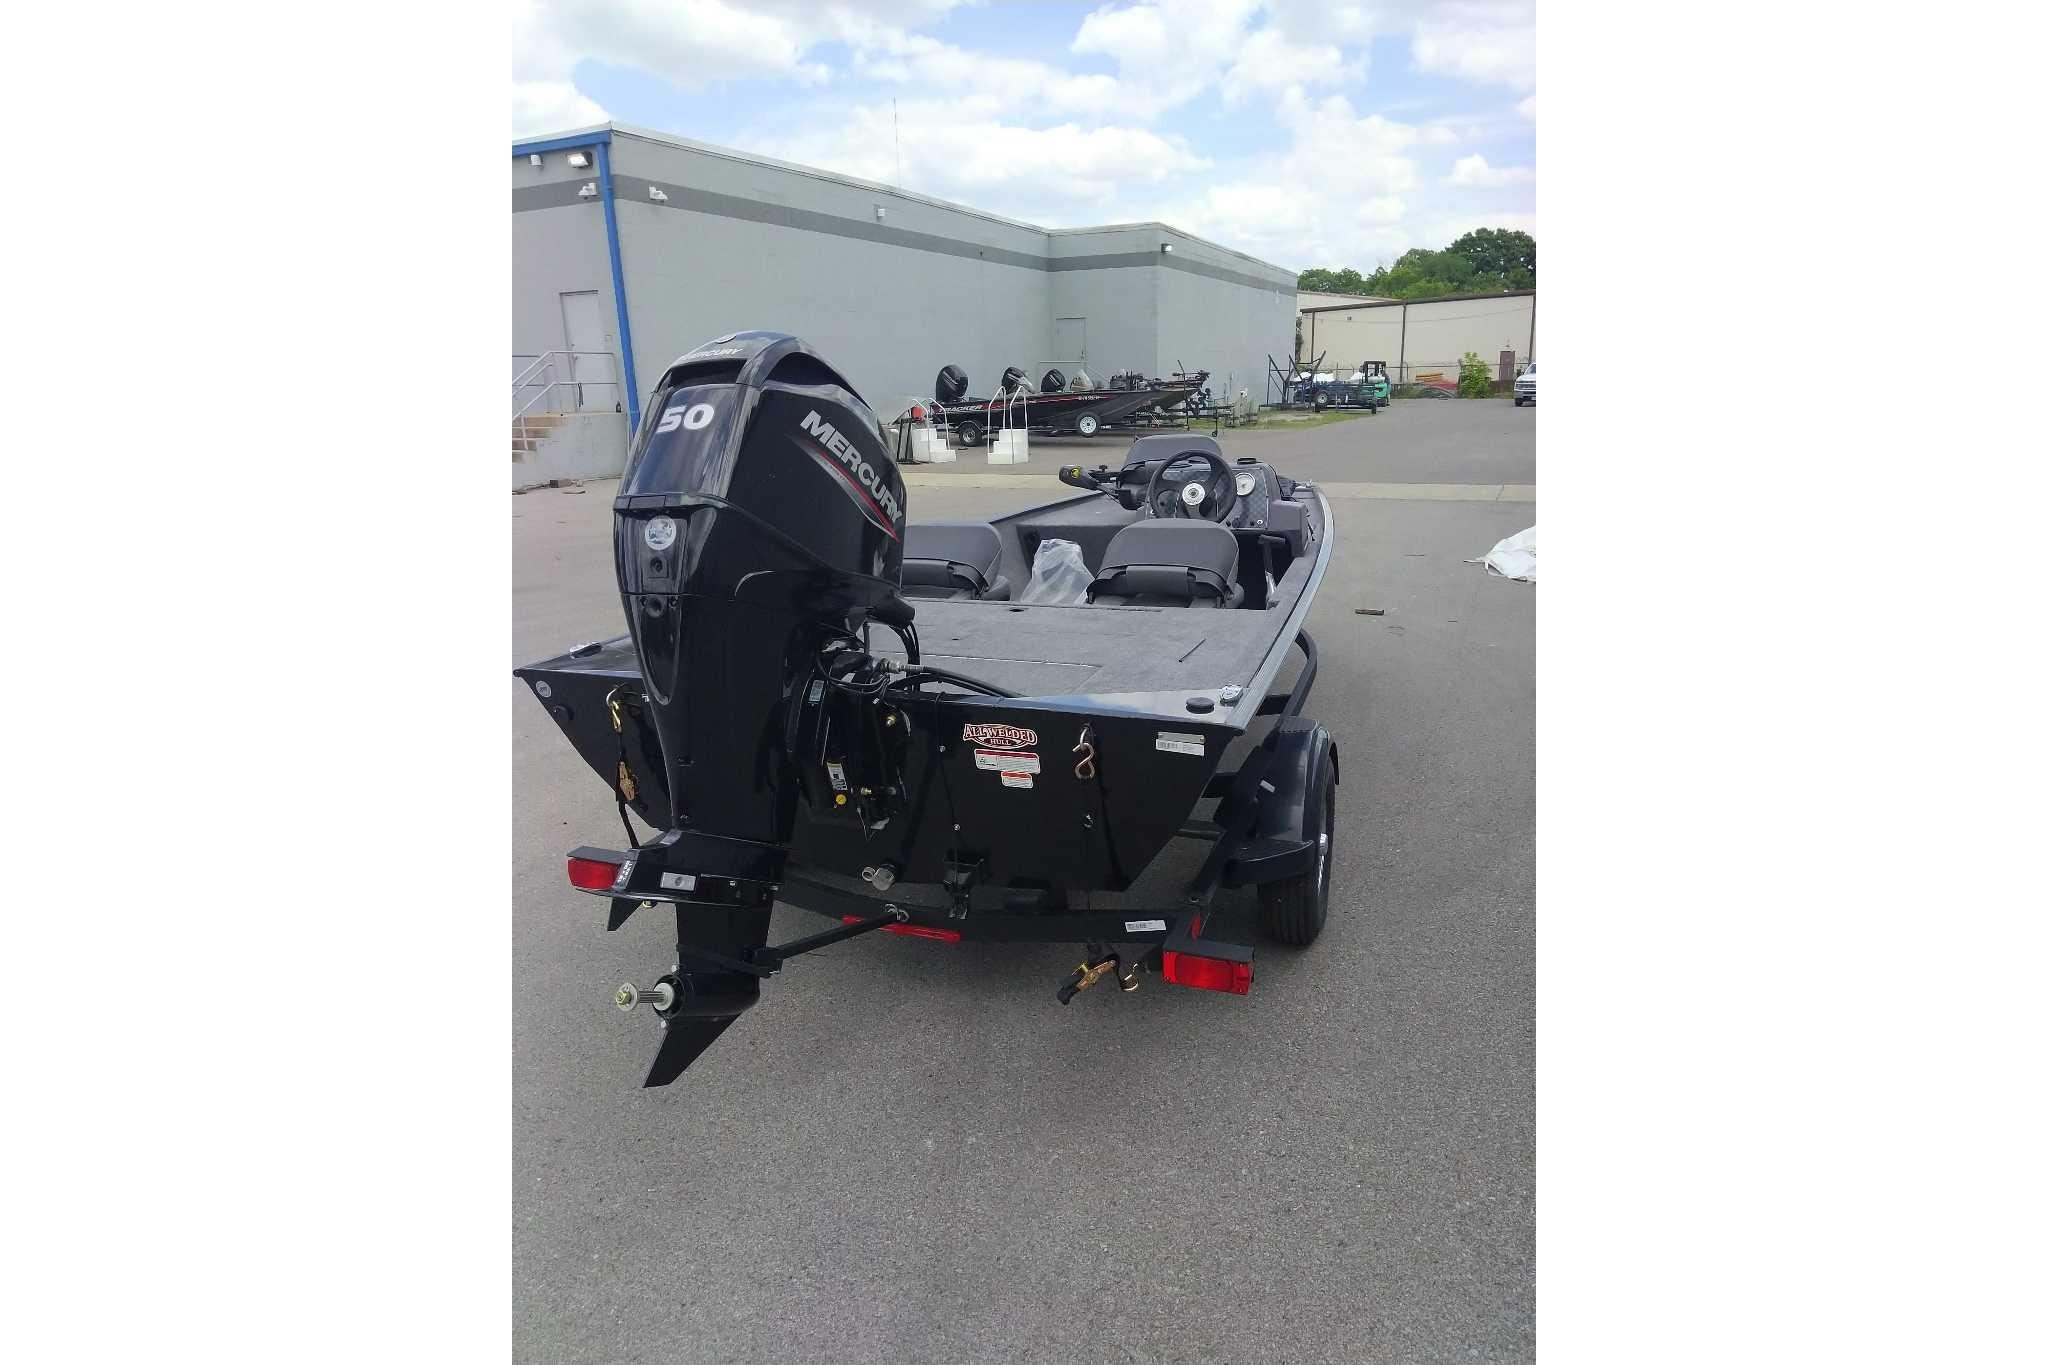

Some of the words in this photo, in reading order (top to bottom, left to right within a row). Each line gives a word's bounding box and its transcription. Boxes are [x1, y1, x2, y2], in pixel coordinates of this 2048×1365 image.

[656, 403, 715, 433] 50
[800, 409, 902, 522] MERCURY
[990, 738, 1011, 746] HULL
